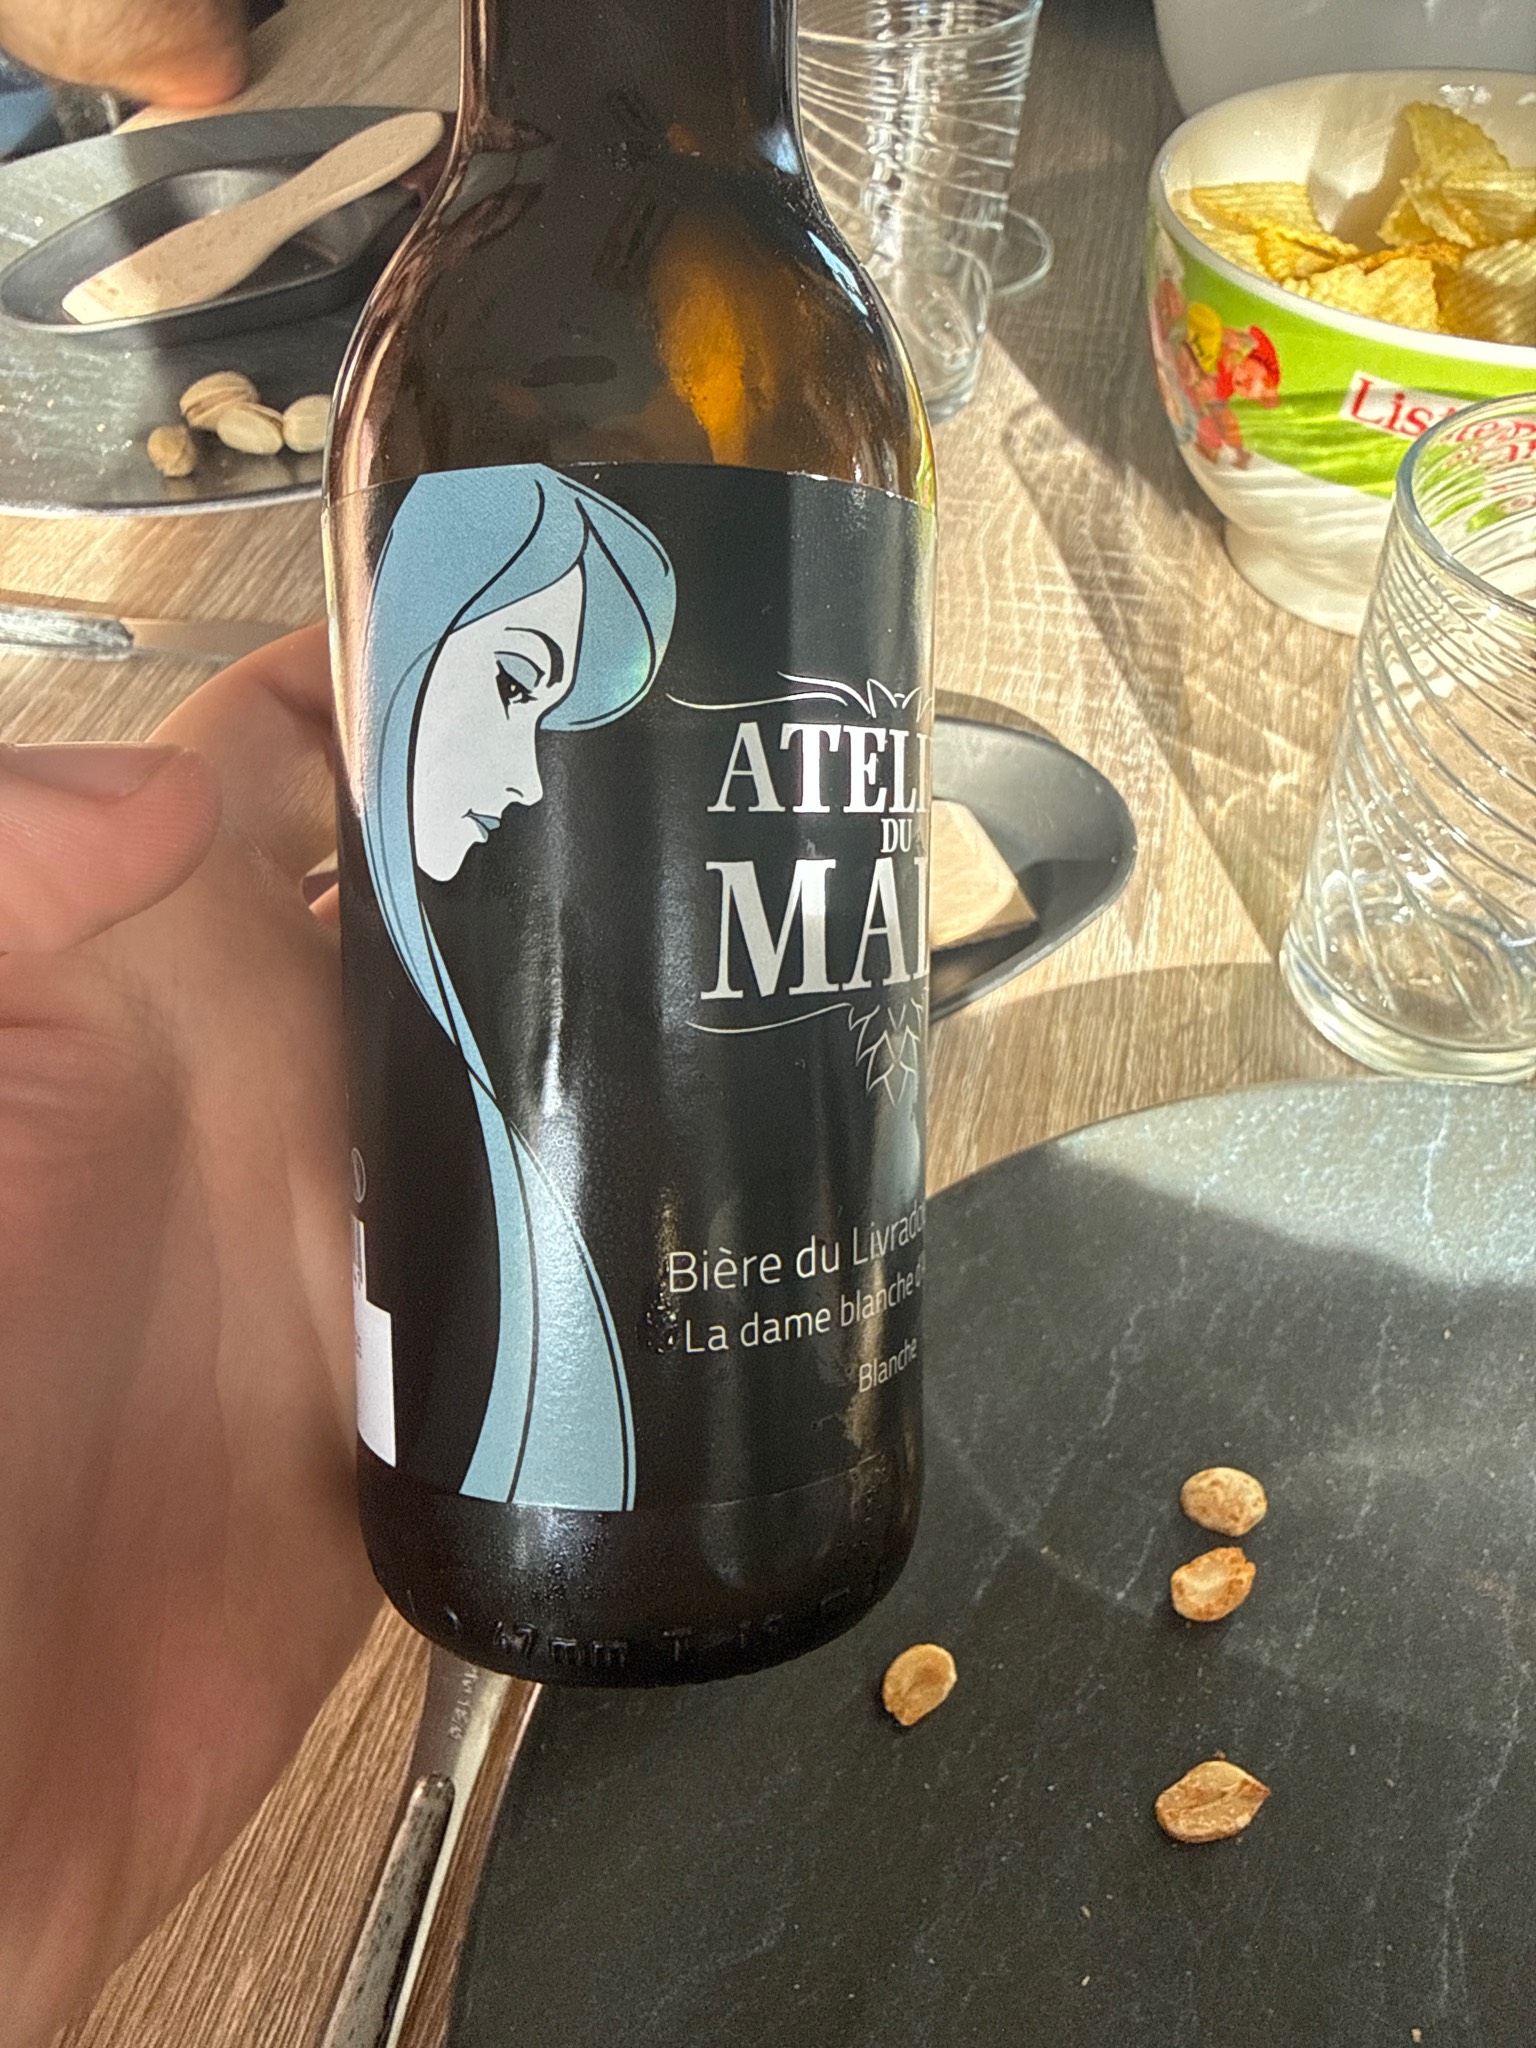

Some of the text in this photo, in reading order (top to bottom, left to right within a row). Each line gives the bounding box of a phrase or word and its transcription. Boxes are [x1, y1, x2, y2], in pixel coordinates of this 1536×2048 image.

[1350, 377, 1456, 437] Lis
[706, 721, 931, 813] ATELI
[881, 818, 912, 853] DU
[669, 1199, 926, 1293] Bière du Livrado
[685, 1319, 729, 1353] La
[740, 1307, 831, 1347] dame
[840, 1272, 914, 1328] blanche
[858, 1337, 918, 1393] Blanche
